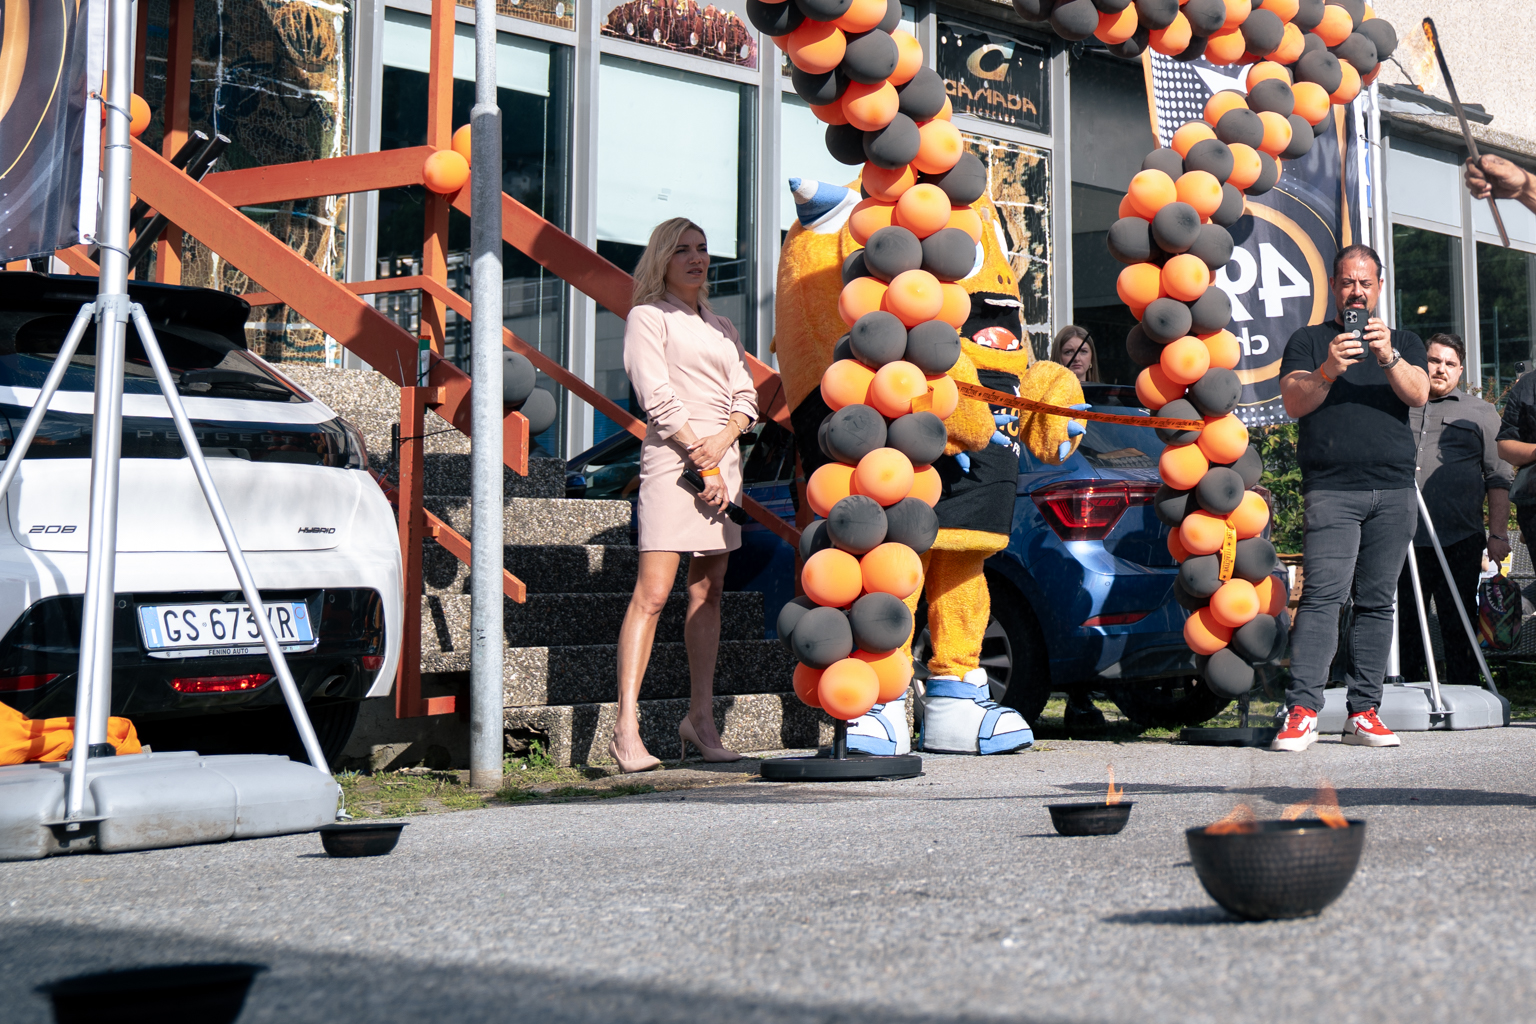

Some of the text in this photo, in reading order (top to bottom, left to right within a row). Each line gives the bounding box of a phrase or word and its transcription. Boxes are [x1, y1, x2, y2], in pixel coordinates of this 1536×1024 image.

[29, 525, 77, 534] 208
[164, 608, 200, 642] GS
[232, 647, 249, 655] AUTO
